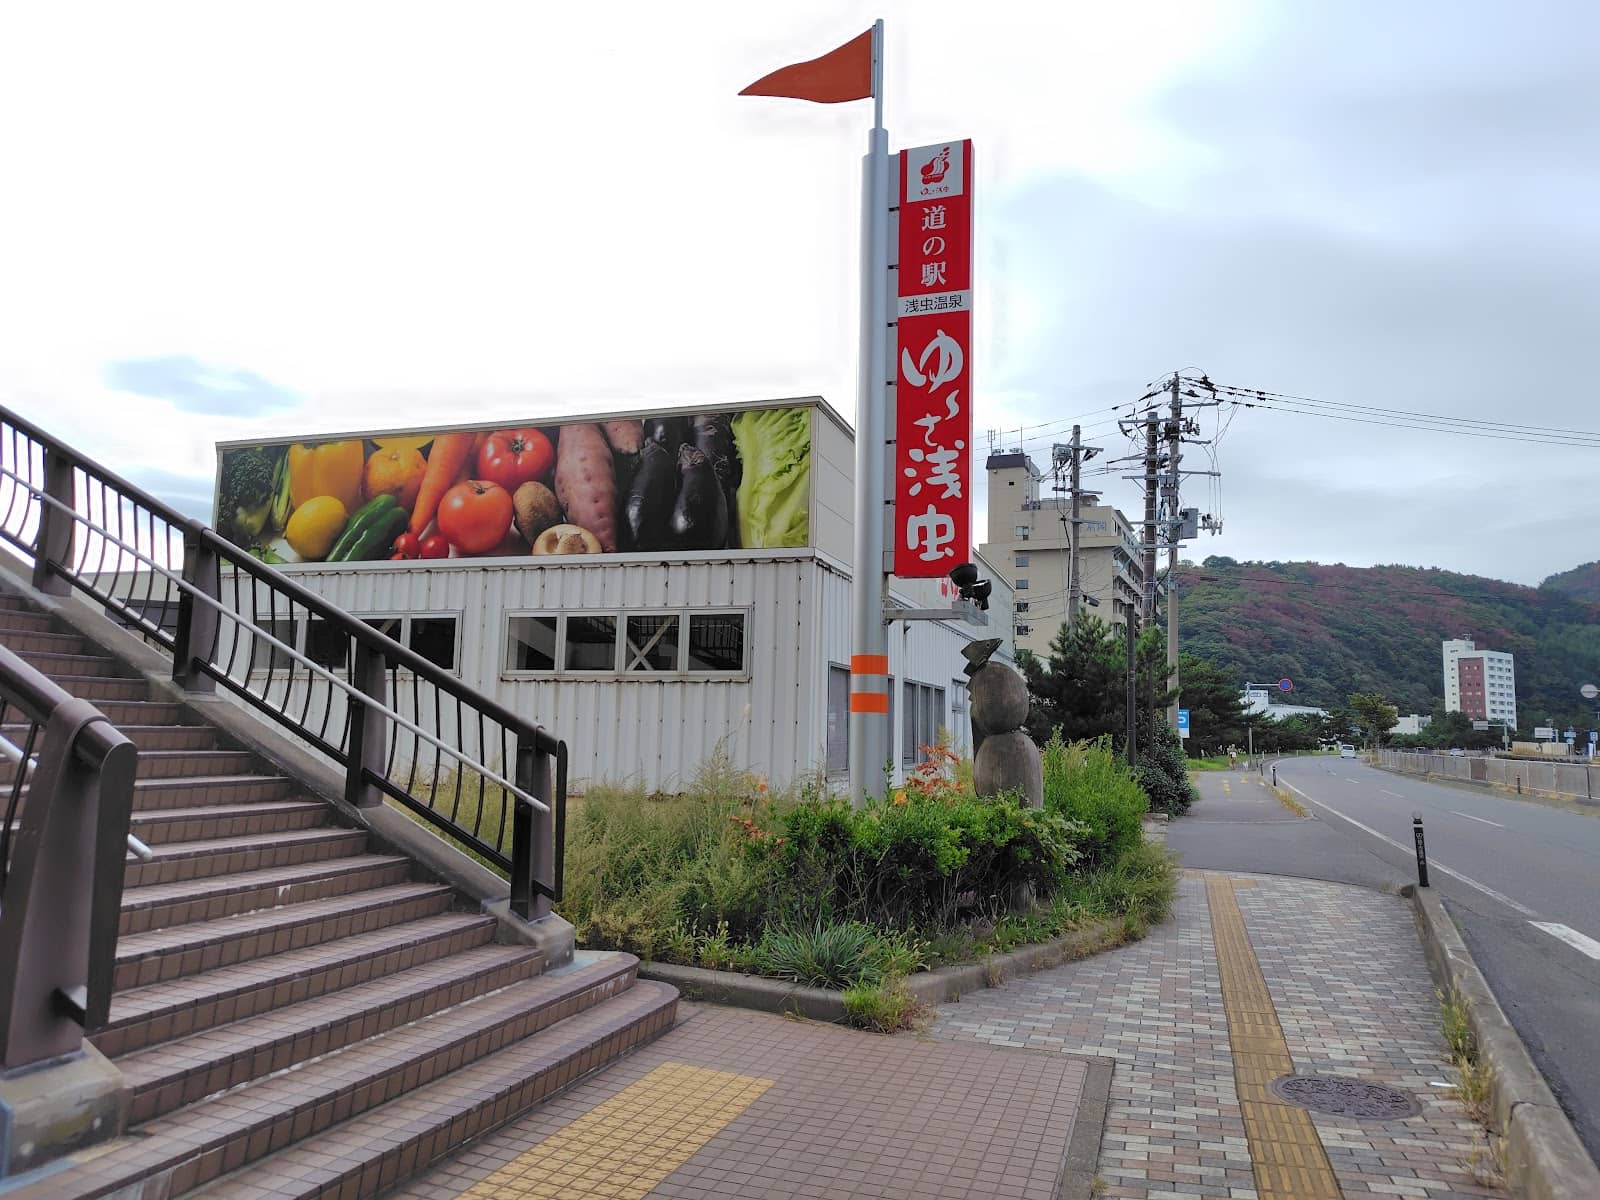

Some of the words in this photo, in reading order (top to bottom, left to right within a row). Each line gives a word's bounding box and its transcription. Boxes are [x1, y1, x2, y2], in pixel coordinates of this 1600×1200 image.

[921, 205, 947, 287] 道の駅
[905, 294, 963, 314] 浅虫温泉
